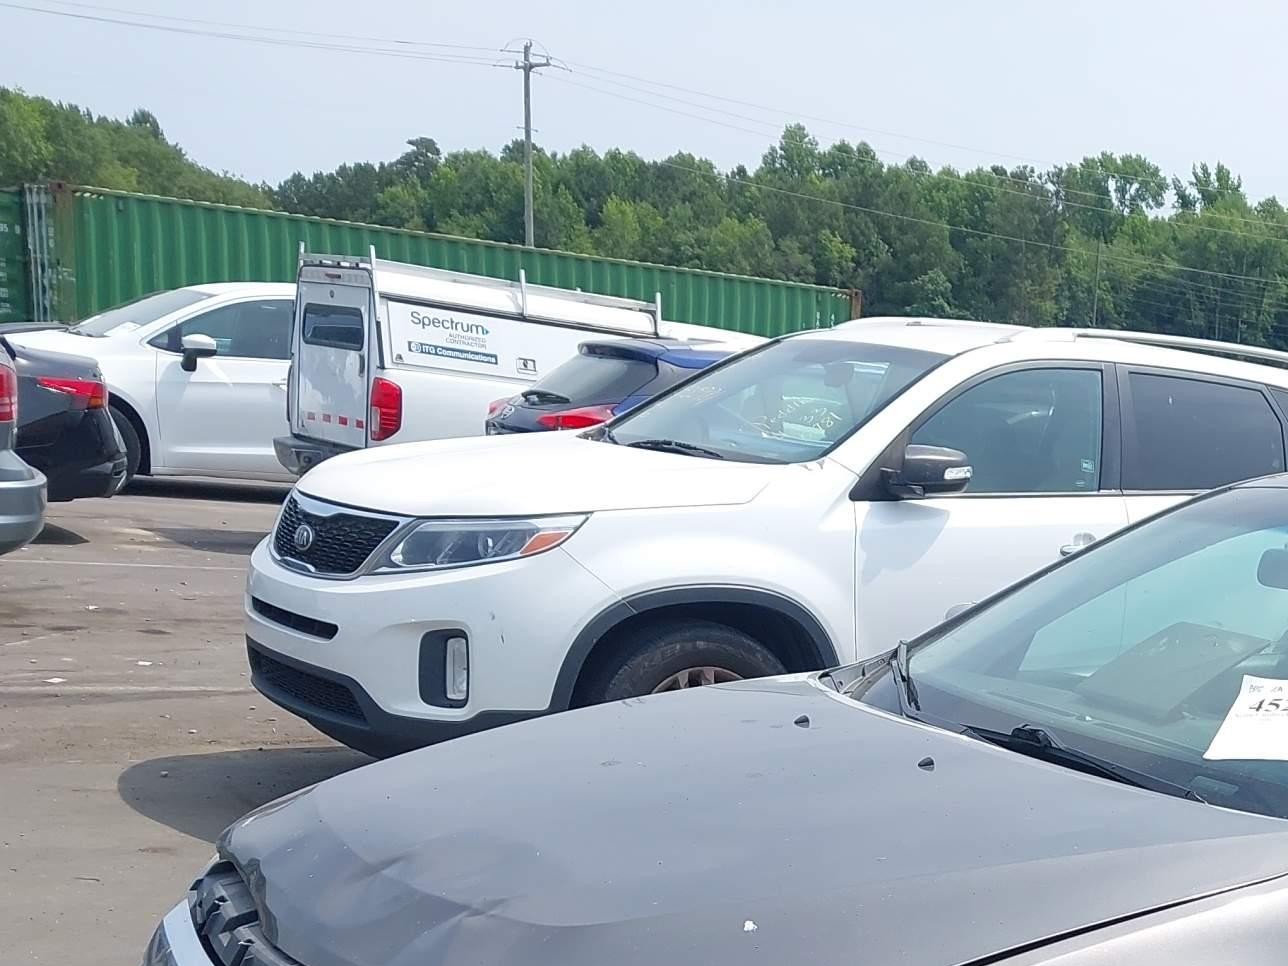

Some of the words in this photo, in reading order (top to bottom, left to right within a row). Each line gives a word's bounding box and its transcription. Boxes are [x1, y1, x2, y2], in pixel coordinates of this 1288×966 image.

[410, 310, 486, 335] Spectrum
[445, 337, 487, 349] CONTRACTOR
[448, 332, 486, 343] AUTHORIZED
[437, 347, 496, 364] Communications
